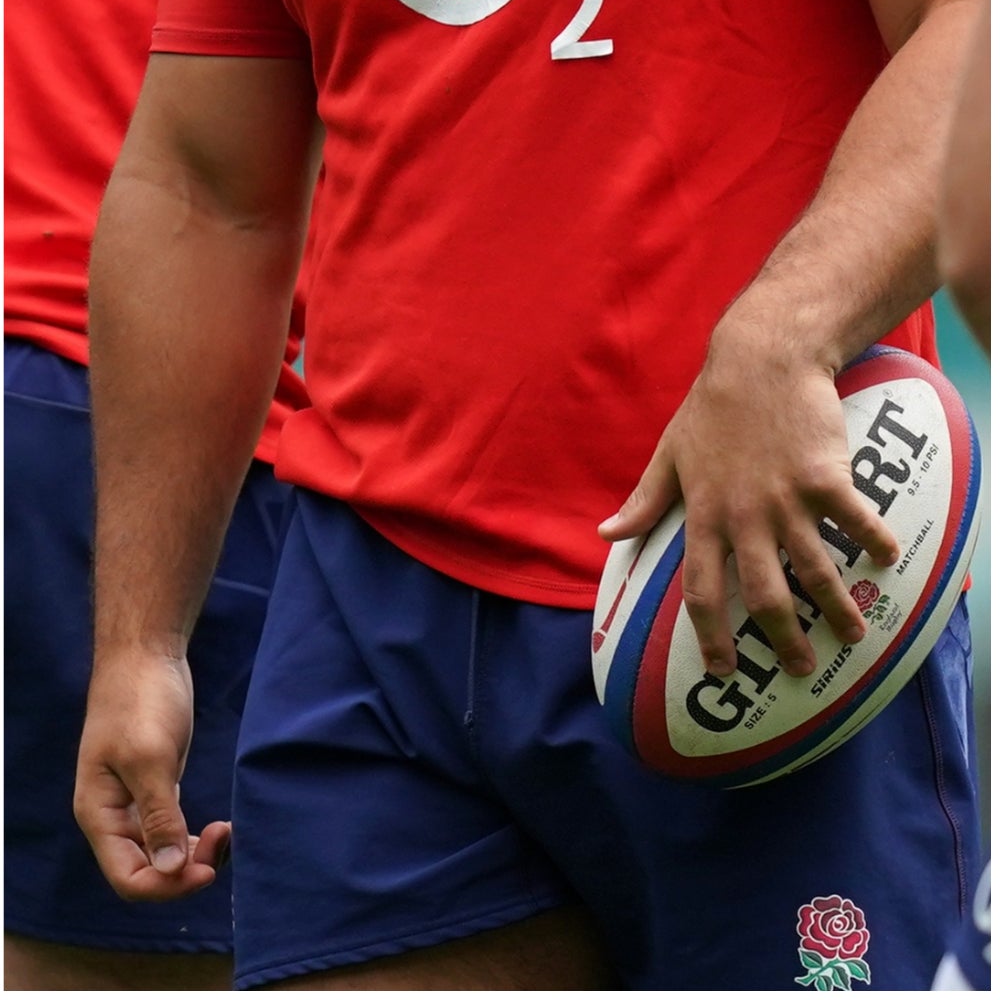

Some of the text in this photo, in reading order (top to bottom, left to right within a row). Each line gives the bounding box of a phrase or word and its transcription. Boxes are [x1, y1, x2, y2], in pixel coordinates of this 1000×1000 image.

[925, 443, 940, 462] PSI
[896, 519, 935, 576] MATCHBALL
[743, 705, 767, 731] SIZE
